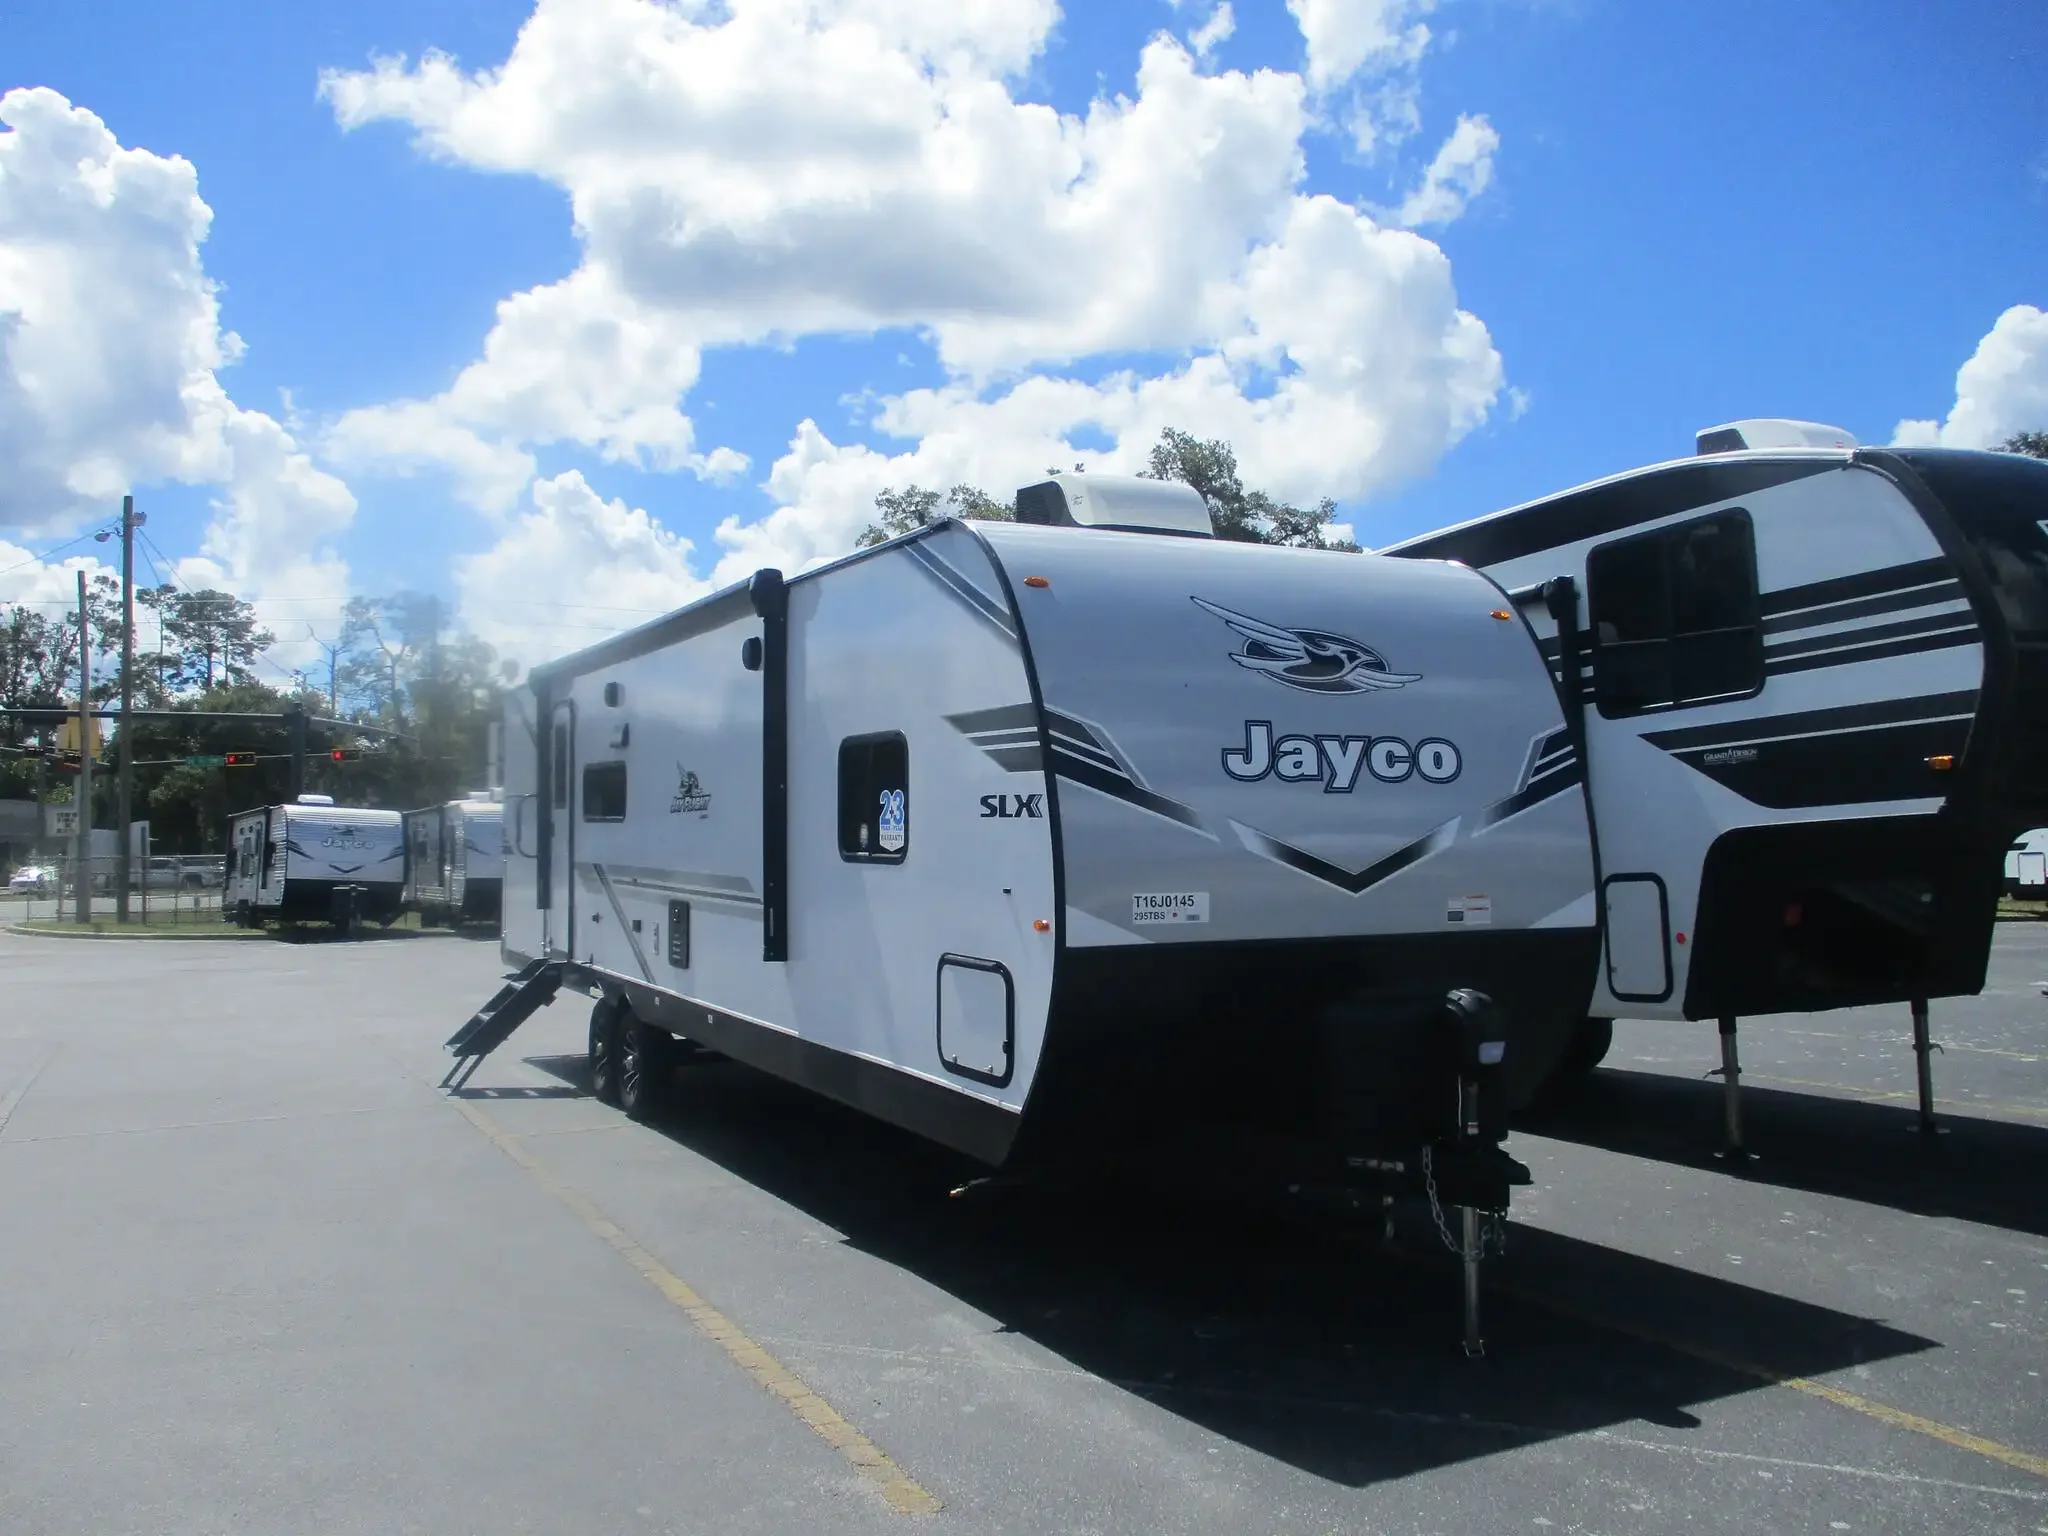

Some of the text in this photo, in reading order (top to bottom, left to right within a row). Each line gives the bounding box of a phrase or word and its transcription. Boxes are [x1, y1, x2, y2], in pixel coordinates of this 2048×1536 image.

[1221, 720, 1462, 793] Jayco
[980, 794, 1043, 817] SLX
[321, 837, 375, 850] Jayco
[1134, 895, 1195, 908] T16J0145
[1134, 911, 1166, 921] 295TBS
